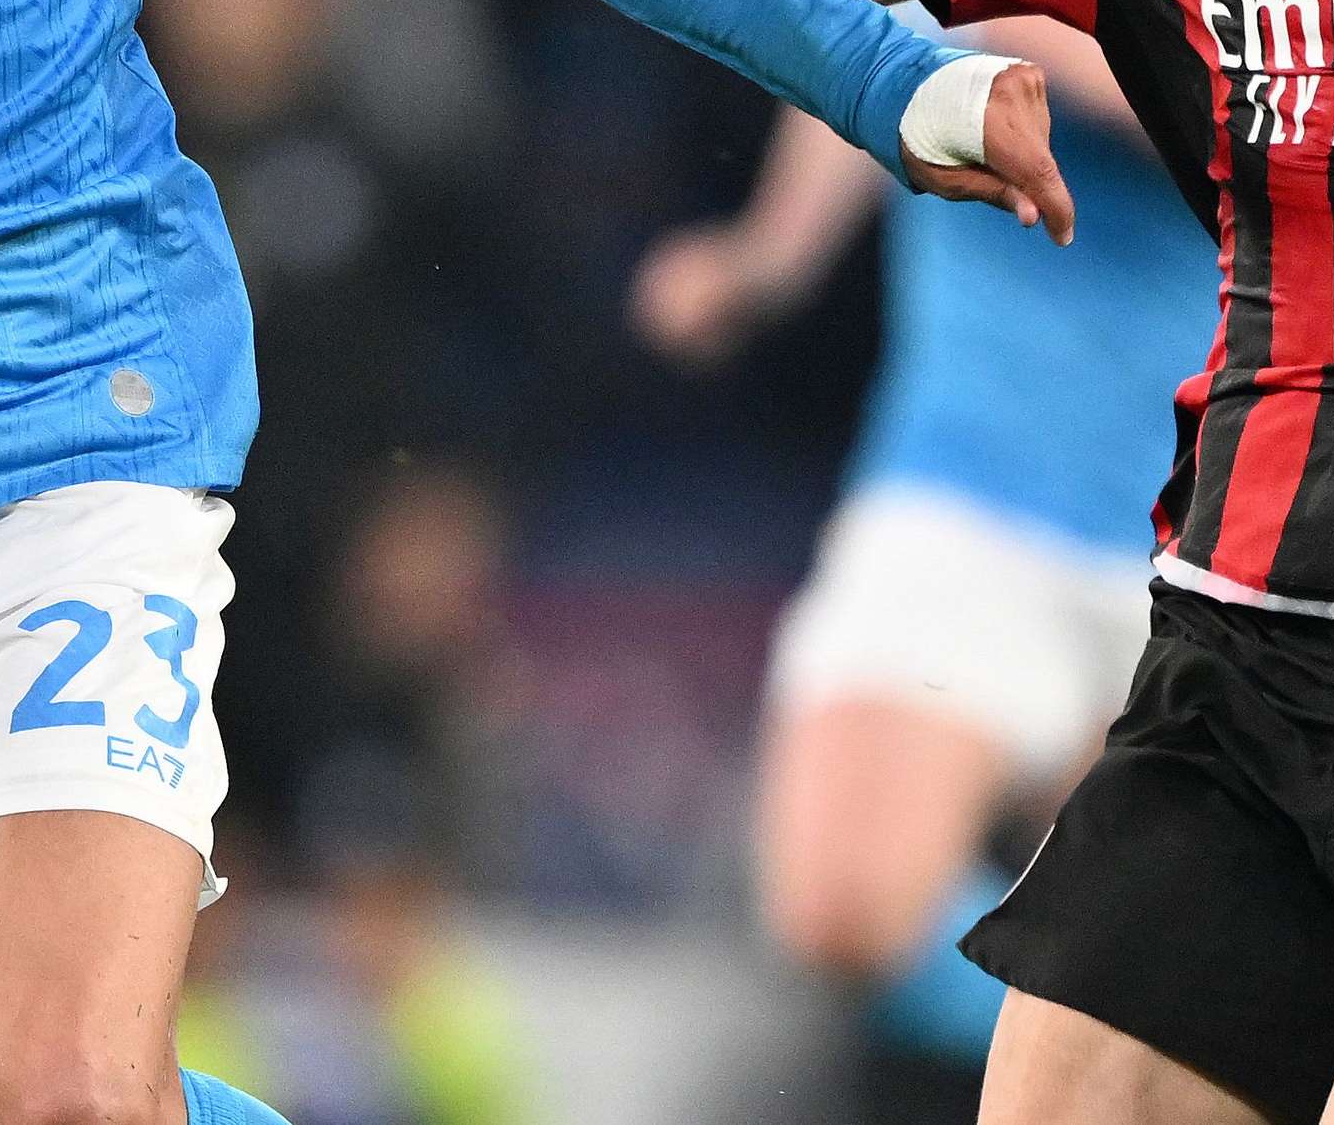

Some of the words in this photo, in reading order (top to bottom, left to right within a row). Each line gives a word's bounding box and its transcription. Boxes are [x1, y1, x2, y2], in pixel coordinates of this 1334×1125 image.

[1245, 74, 1322, 146] FLY
[9, 594, 201, 750] 23
[106, 735, 185, 789] EA7
